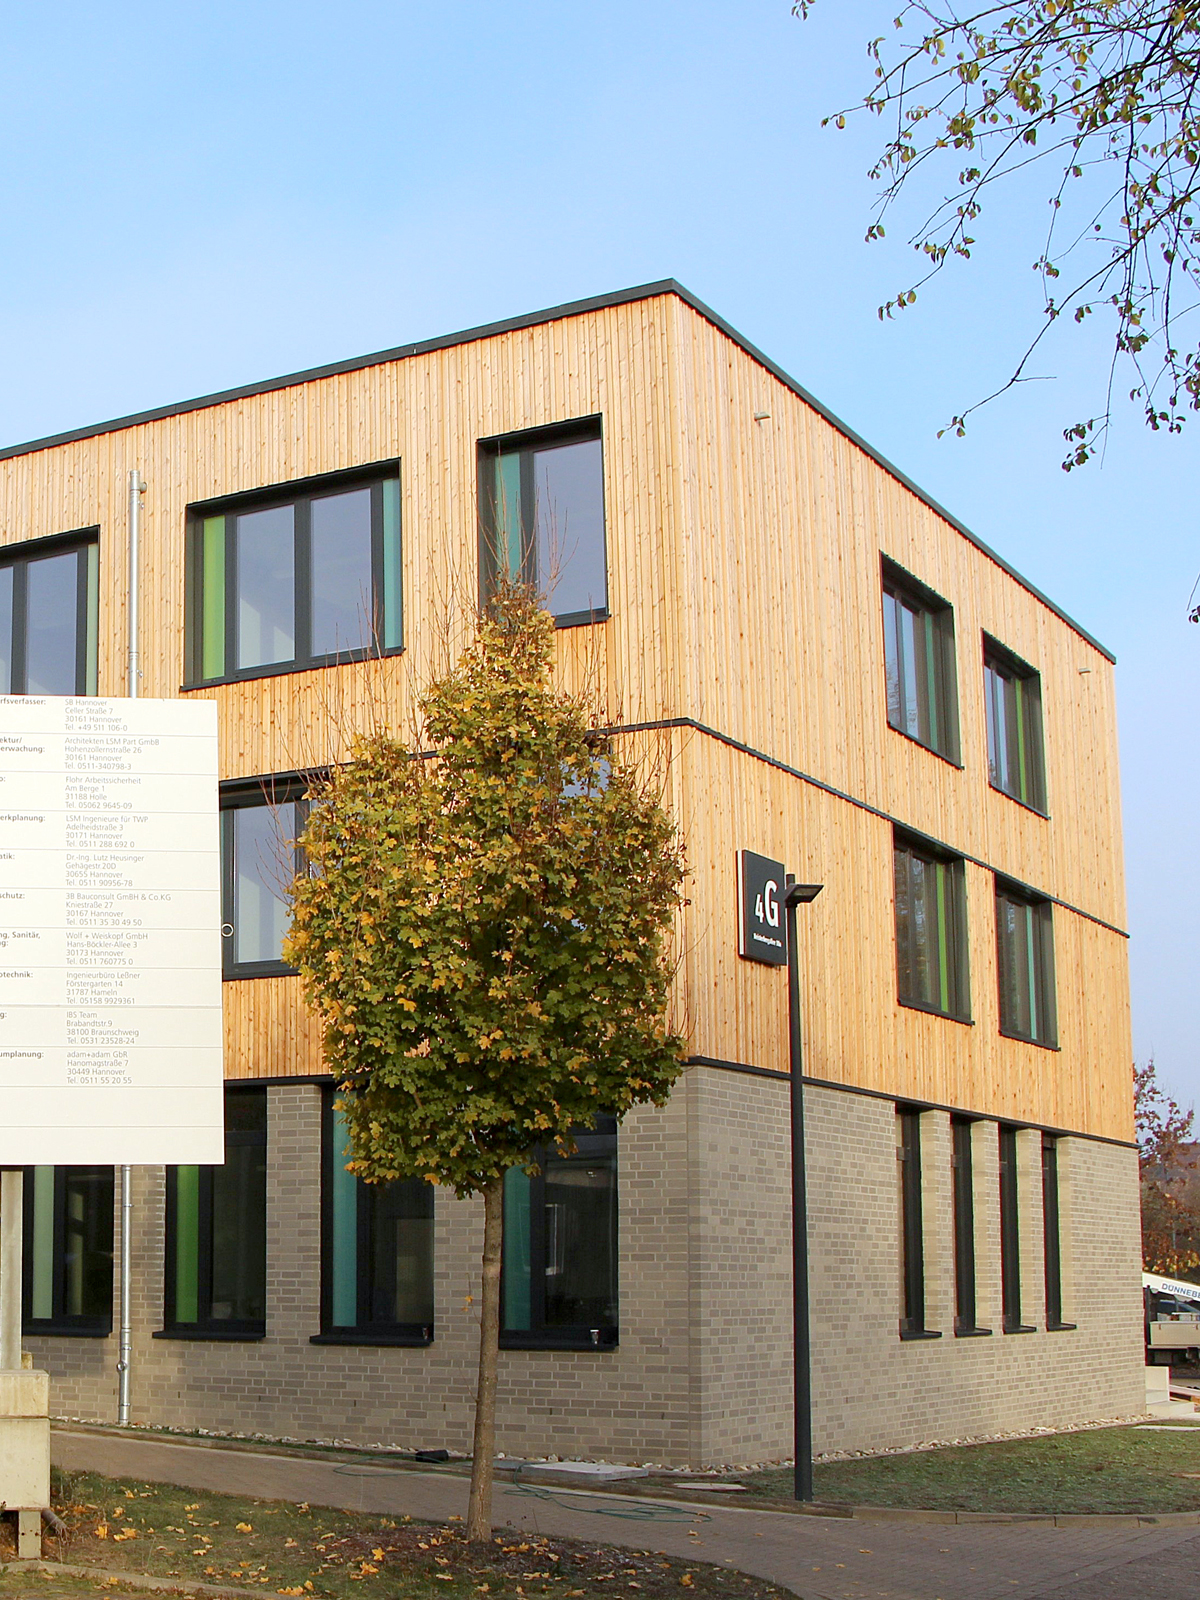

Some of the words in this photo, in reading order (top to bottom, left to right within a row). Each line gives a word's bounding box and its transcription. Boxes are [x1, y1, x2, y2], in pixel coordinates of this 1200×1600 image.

[78, 785, 99, 794] Berge
[82, 815, 119, 824] Ingenieure
[109, 855, 144, 863] Heusinger
[755, 880, 779, 928] 4G
[12, 932, 40, 940] Sanitär,
[91, 933, 123, 942] Weiskopf
[66, 972, 115, 981] Ingenieurbüro
[65, 980, 112, 989] Förstergarten
[90, 1029, 139, 1038] Braunschweig
[66, 1060, 122, 1068] Hanomagstraße
